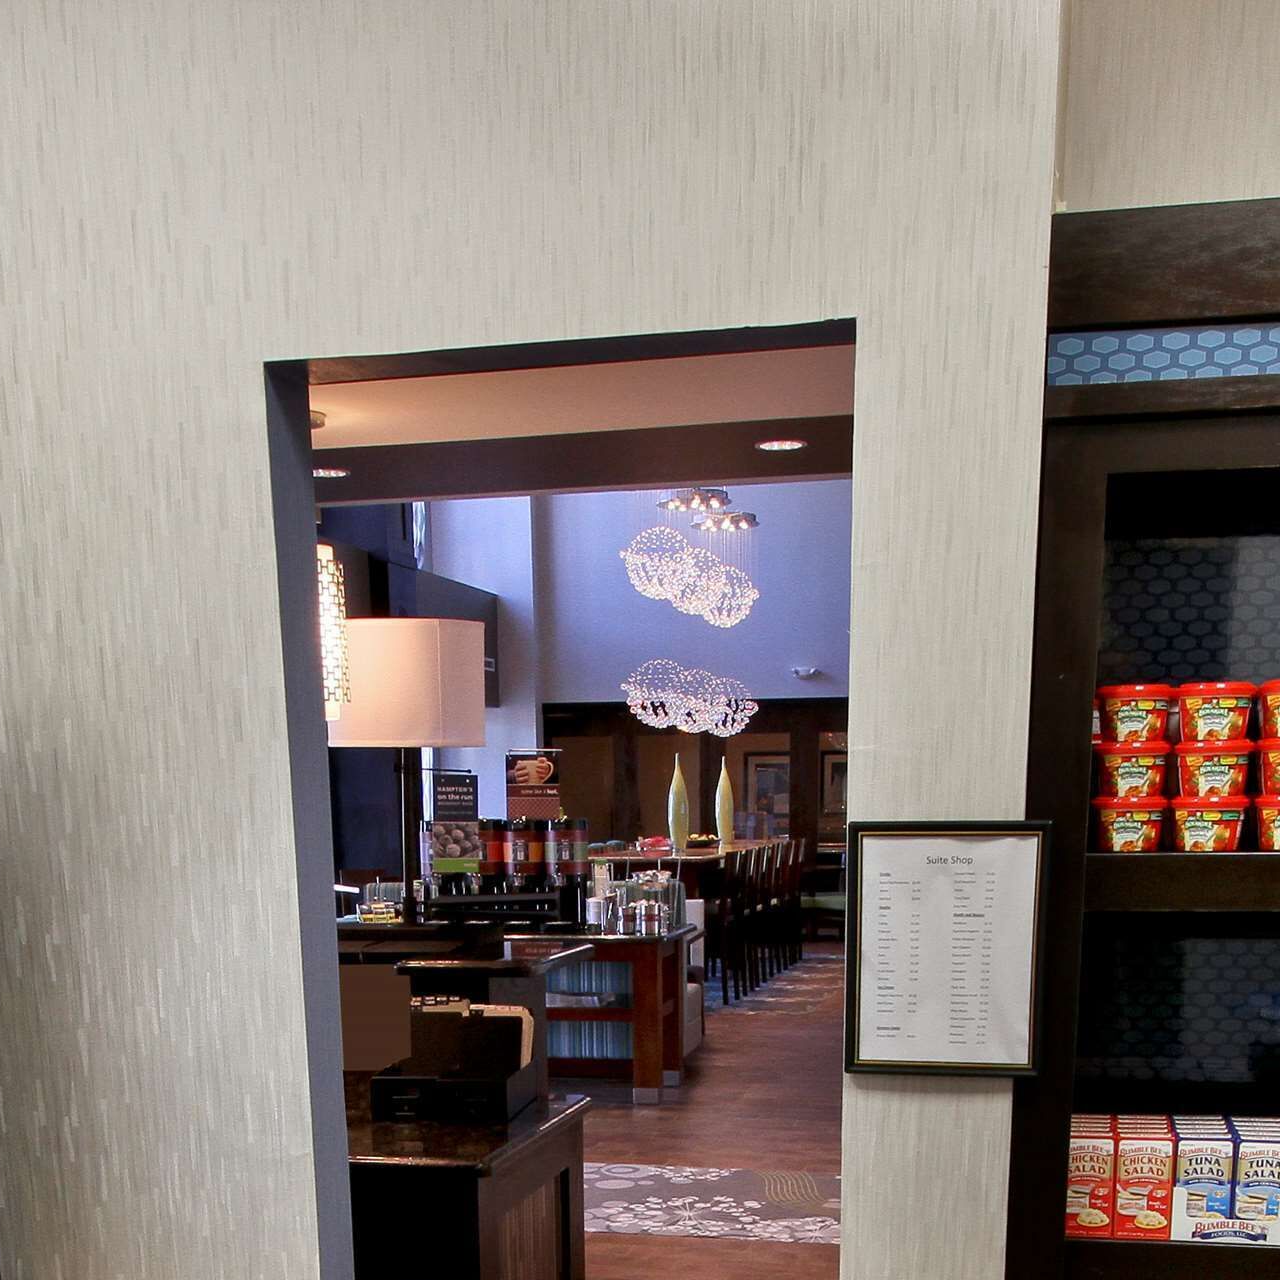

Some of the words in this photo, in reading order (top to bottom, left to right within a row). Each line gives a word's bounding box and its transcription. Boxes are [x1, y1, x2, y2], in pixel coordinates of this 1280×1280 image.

[926, 856, 949, 865] Suite
[950, 856, 974, 866] Shop
[1071, 1154, 1109, 1166] HICKEN
[1122, 1155, 1167, 1168] CHICKEN
[1187, 1156, 1222, 1167] TUNA
[1124, 1166, 1164, 1177] SALAD
[1184, 1166, 1224, 1178] SALAD
[1195, 1220, 1238, 1234] BUMBLE
[1239, 1221, 1257, 1232] BEE
